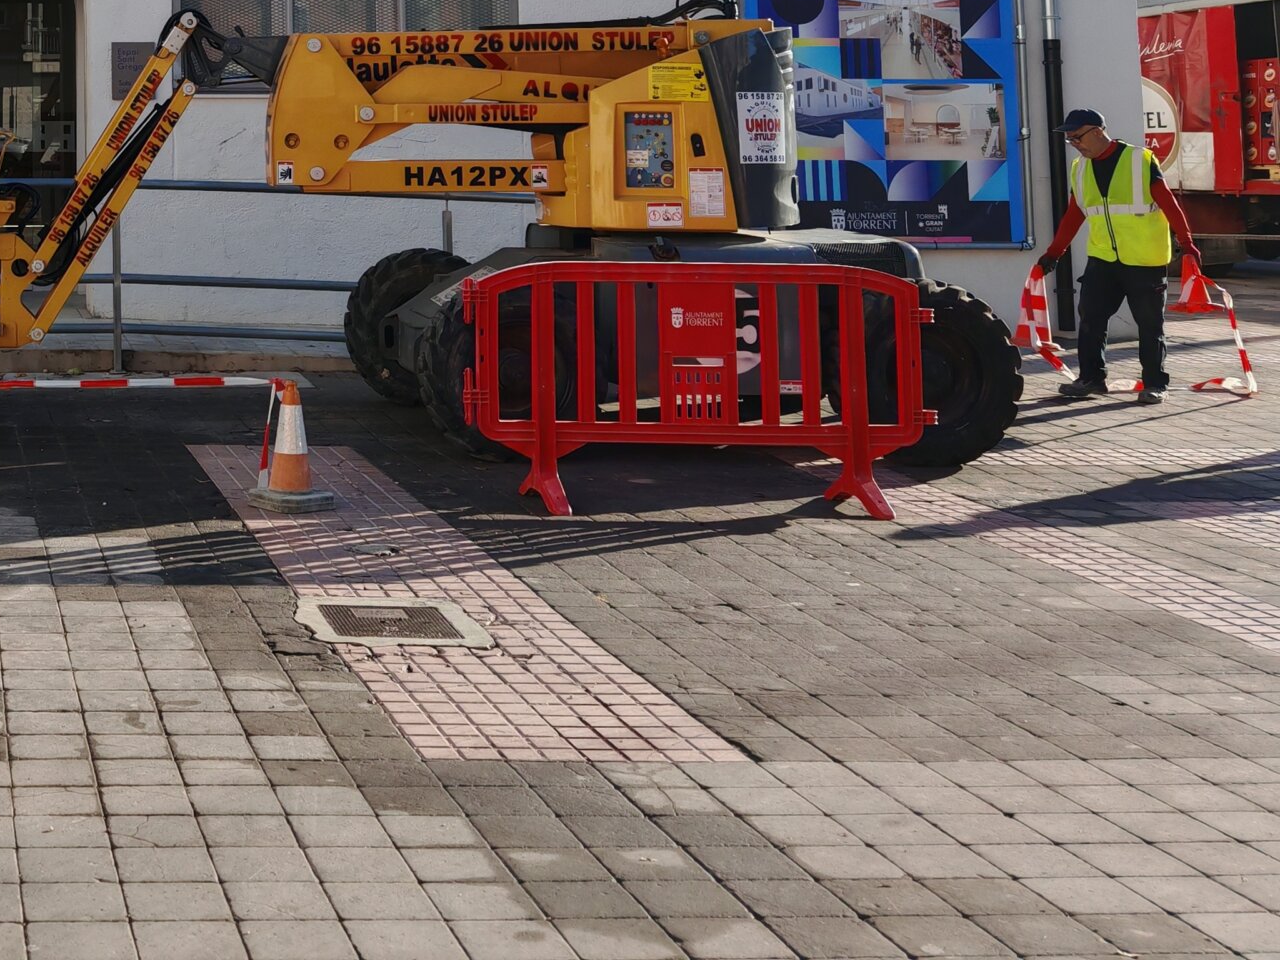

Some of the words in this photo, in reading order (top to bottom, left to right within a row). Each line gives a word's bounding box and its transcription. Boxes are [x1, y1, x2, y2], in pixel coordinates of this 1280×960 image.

[351, 37, 381, 56] 96
[390, 33, 462, 55] 15887
[473, 34, 505, 53] 26
[509, 31, 579, 53] UNION
[428, 105, 477, 123] UNION
[1143, 111, 1168, 129] EL
[106, 112, 138, 150] UNION
[129, 163, 147, 181] 96
[140, 141, 160, 163] 158
[152, 124, 170, 142] 87
[163, 109, 180, 127] 26
[404, 165, 531, 188] HA12PX
[48, 227, 66, 244] 96
[60, 203, 80, 227] 158
[72, 187, 89, 206] 87
[82, 172, 99, 190] 26
[847, 212, 897, 220] AJUNTAMENT
[846, 219, 898, 230] TORRENT
[75, 207, 119, 267] ALQUILER
[685, 318, 724, 327] TORRENT
